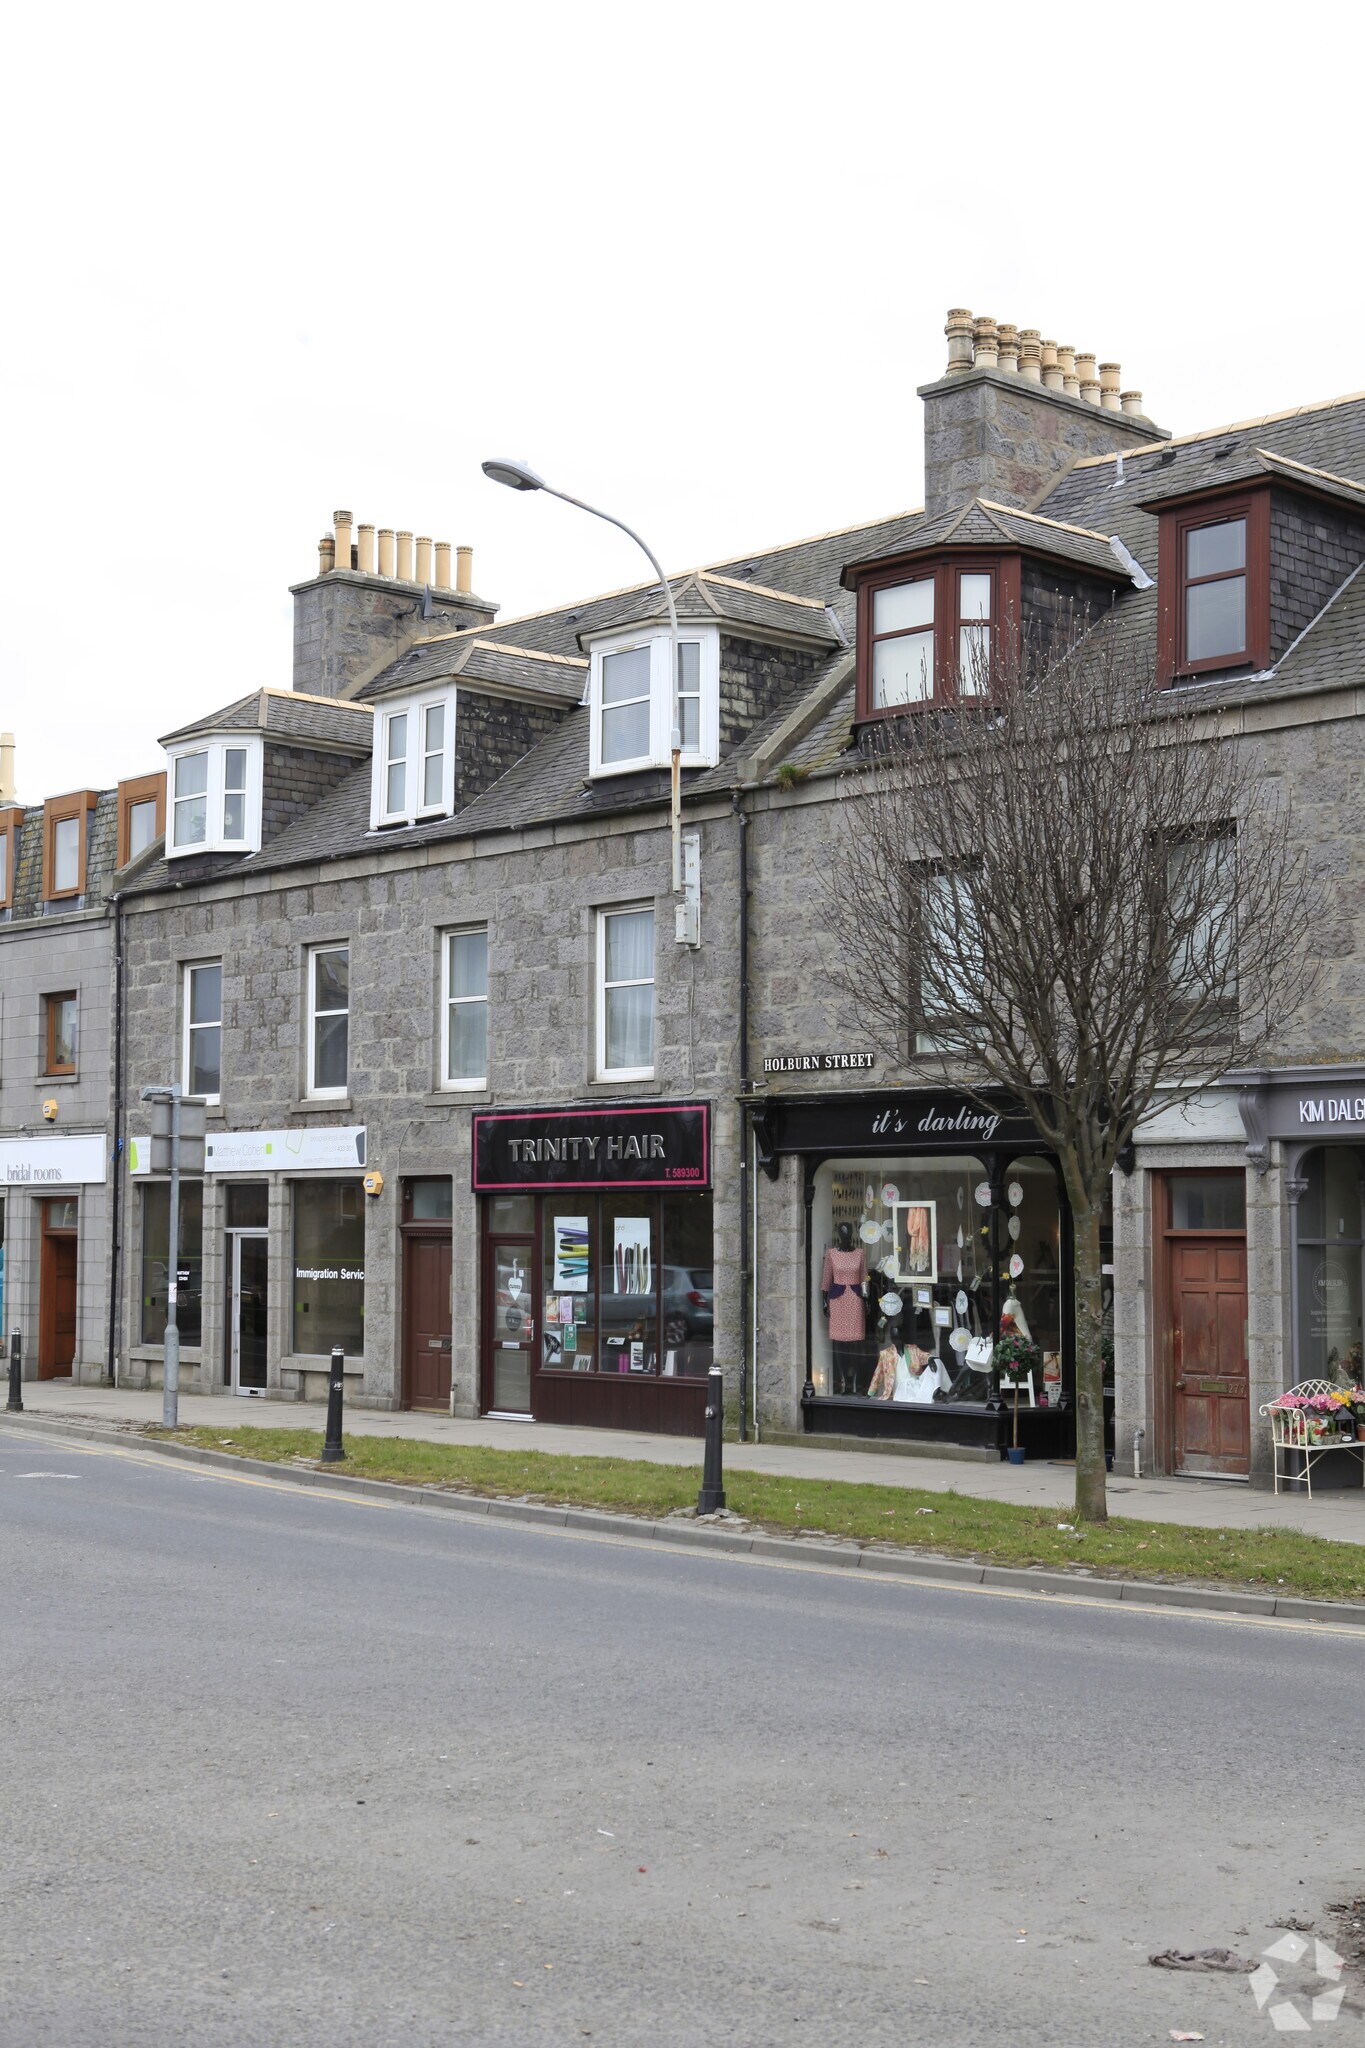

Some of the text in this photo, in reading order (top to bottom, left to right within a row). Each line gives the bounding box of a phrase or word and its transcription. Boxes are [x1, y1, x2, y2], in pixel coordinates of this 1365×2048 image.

[764, 1053, 873, 1072] HOLBURN STREET
[1299, 1099, 1325, 1123] KIM
[872, 1105, 1003, 1141] it's darling
[214, 1143, 265, 1157] Matthew Cohen
[508, 1134, 666, 1162] TRINITY HAIR
[7, 1163, 62, 1182] bridal rooms
[665, 1167, 700, 1178] T. 589300
[296, 1267, 338, 1281] Immigration
[1228, 1383, 1246, 1394] 277
